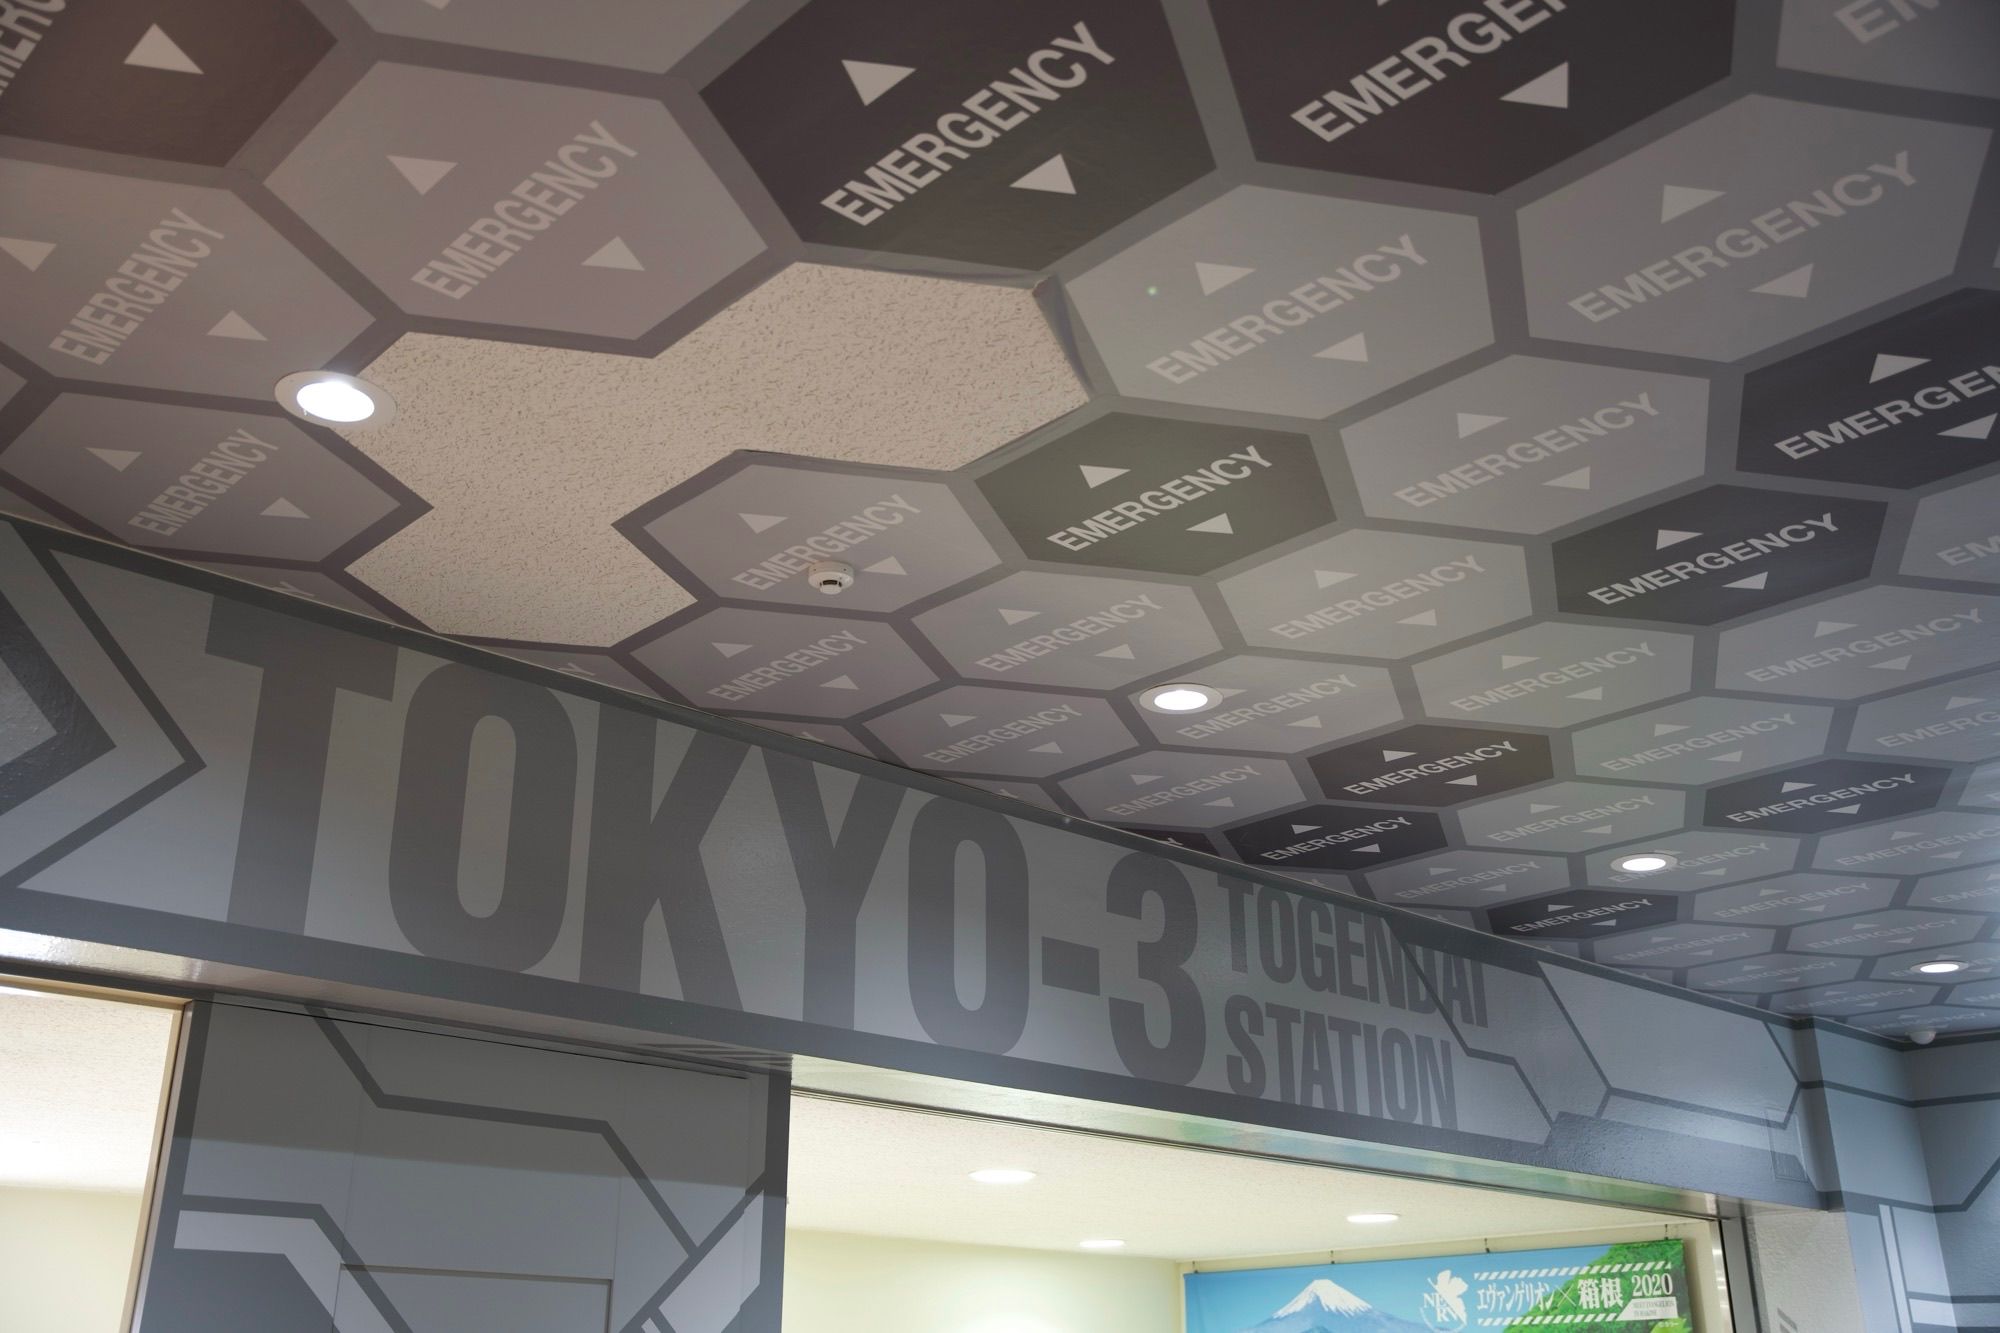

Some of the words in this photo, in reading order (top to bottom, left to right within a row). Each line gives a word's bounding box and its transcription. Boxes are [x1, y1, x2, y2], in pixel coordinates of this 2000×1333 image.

[1290, 0, 1567, 142] EMERGE
[820, 21, 1115, 226] EMERGENCY
[411, 121, 637, 300] EMERGENCY
[1568, 151, 1918, 322] EMERGENCY
[48, 208, 225, 365] EMERGENCY
[1145, 234, 1429, 384] EMERGENCY
[128, 429, 280, 537] EMERGENCY
[1394, 392, 1661, 508] EMERGENCY
[1046, 445, 1273, 551] EMERGENCY
[732, 494, 921, 590] EMERGENCY
[1587, 512, 1839, 605] EMERGENCY
[975, 594, 1163, 672] EMERGENCY
[1269, 555, 1488, 640] EMERGENCY
[706, 630, 868, 701] EMERGENCY
[1450, 642, 1657, 711] EMERGENCY
[1745, 607, 1984, 683] EMERGENCY
[923, 704, 1082, 764] EMERGENCY
[1177, 673, 1359, 740] EMERGENCY
[1600, 713, 1797, 773] EMERGENCY
[1105, 765, 1263, 817] EMERGENCY
[1343, 740, 1519, 797] EMERGENCY
[1726, 773, 1916, 824] EMERGENCY
[205, 592, 1207, 1090] TOKYO-3
[1261, 816, 1413, 862] EMERGENCY
[1488, 795, 1657, 843] EMERGENCY
[1393, 861, 1542, 899] EMERGENCY
[1510, 898, 1653, 934] EMERGENCY
[1713, 882, 1871, 918] EMERGENCY
[1217, 873, 1489, 1029] TOGENDAI
[1224, 994, 1459, 1131] STATION
[1632, 1273, 1673, 1297] 2020
